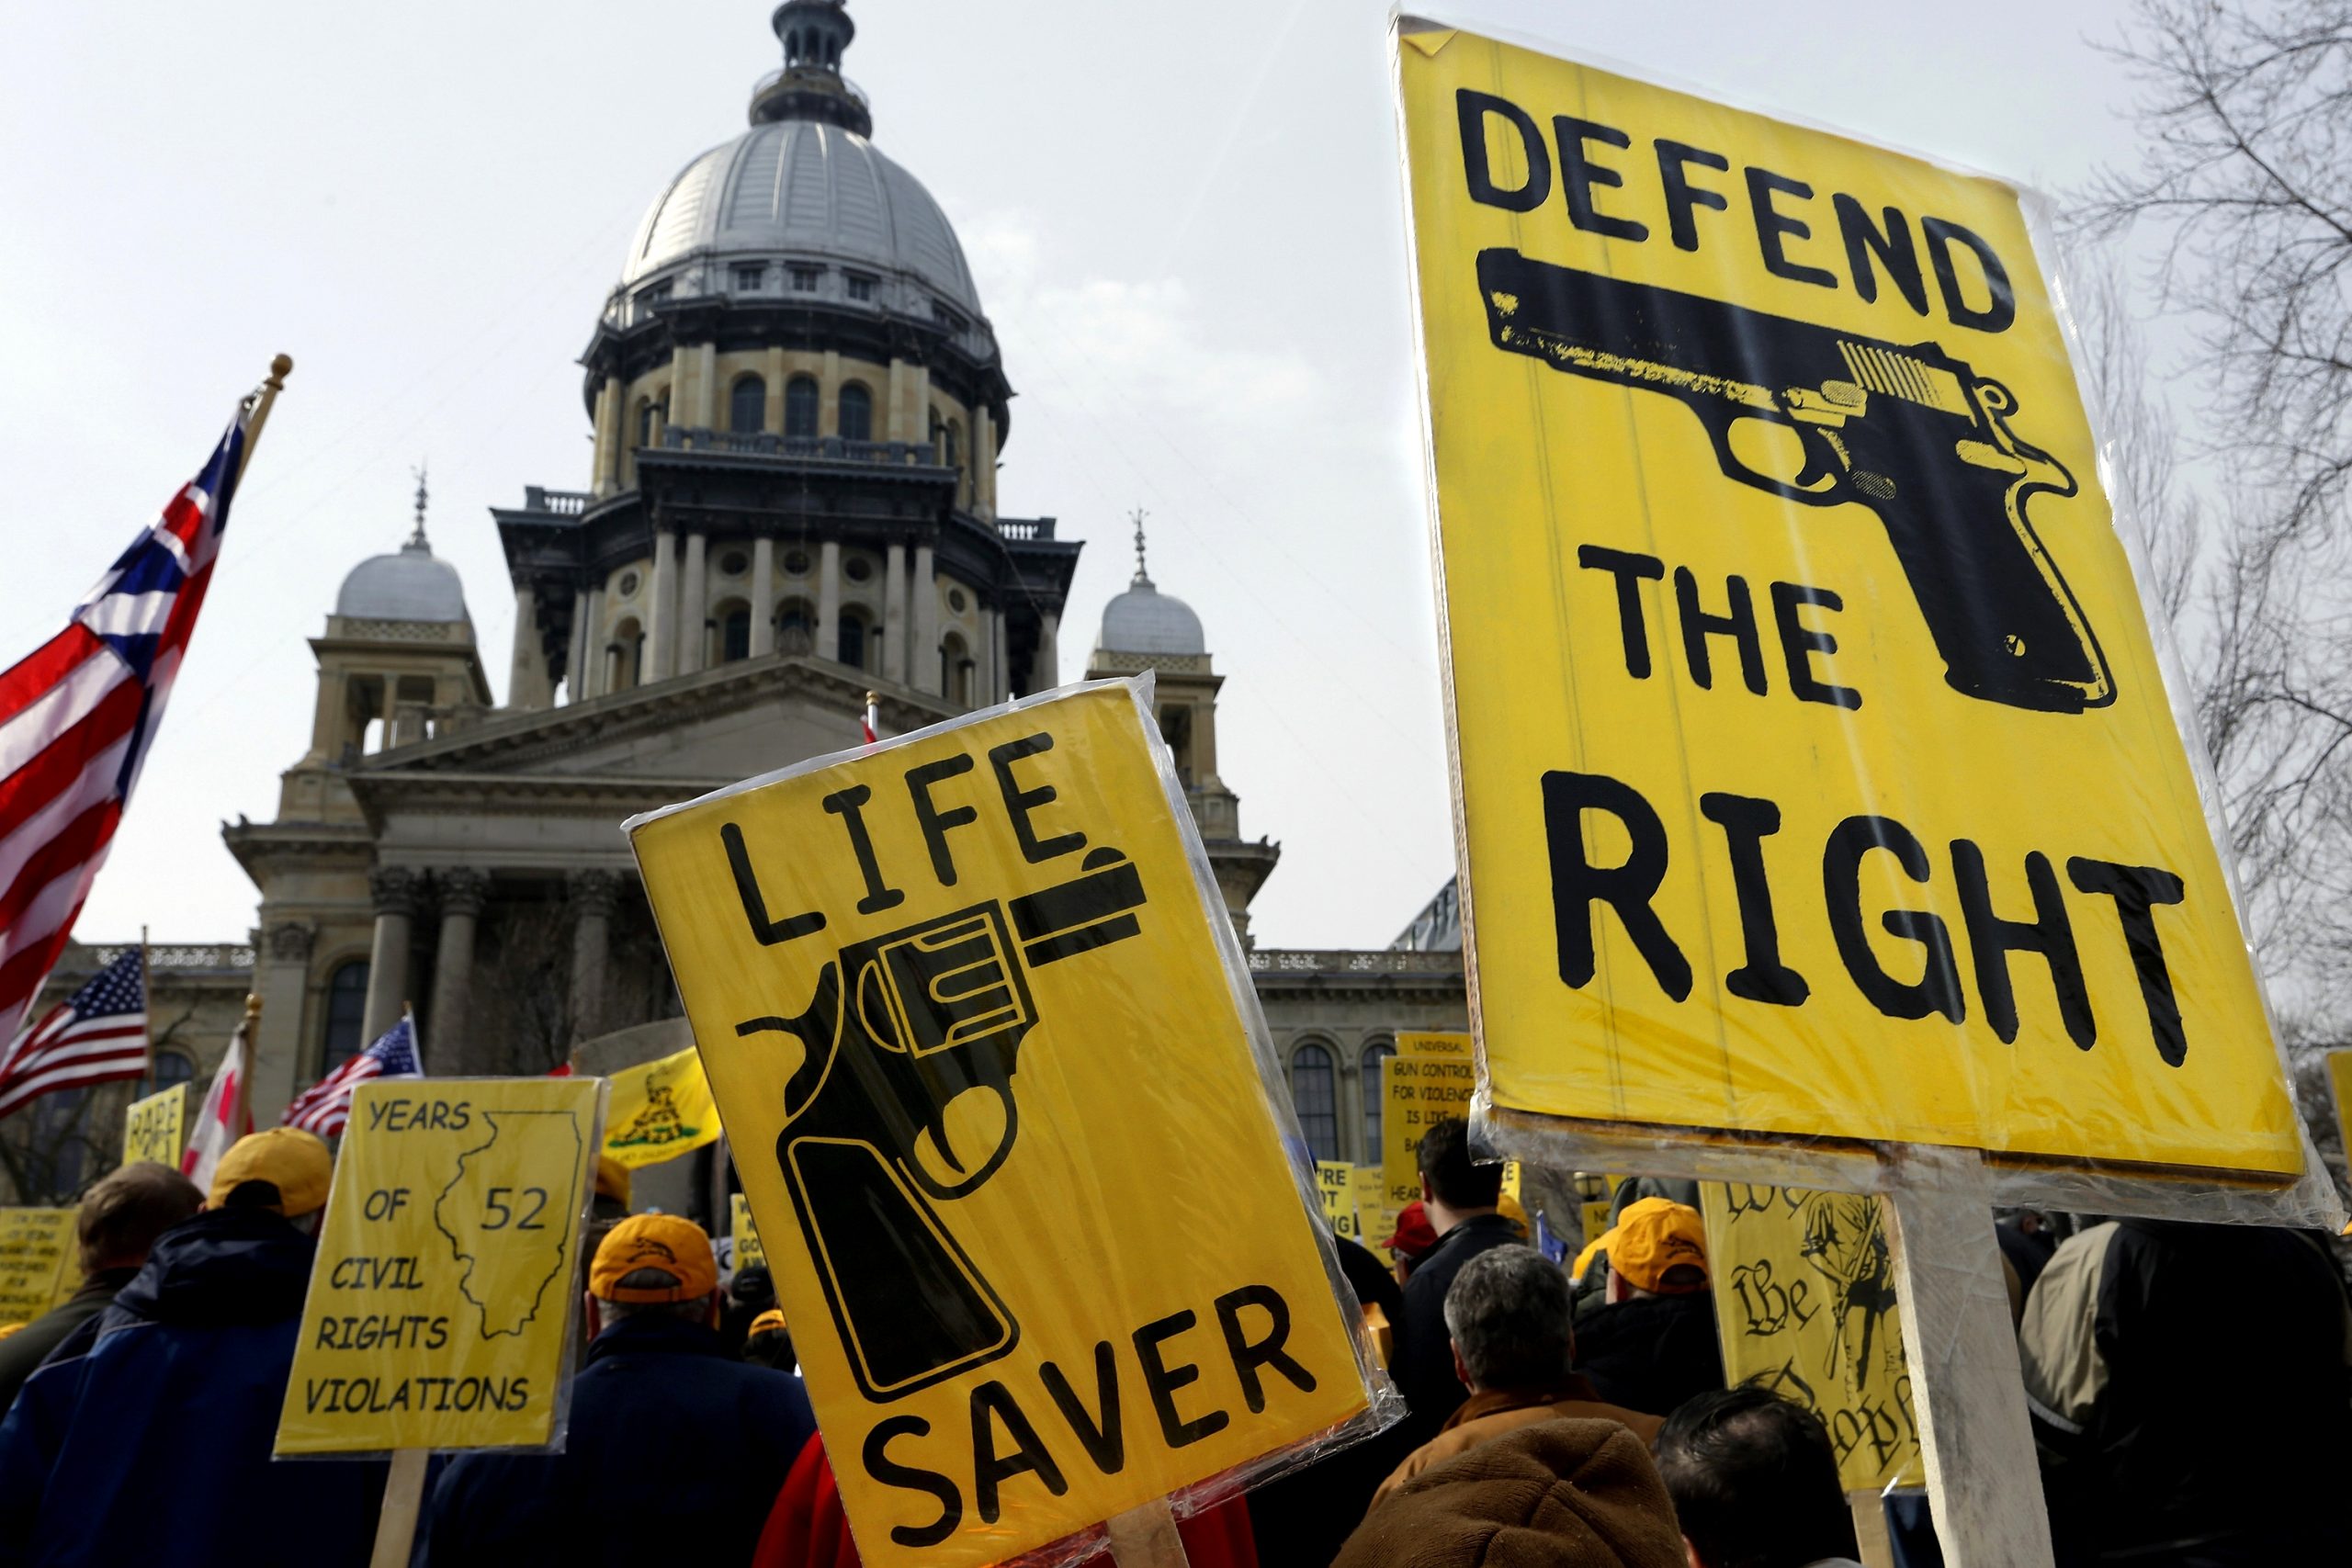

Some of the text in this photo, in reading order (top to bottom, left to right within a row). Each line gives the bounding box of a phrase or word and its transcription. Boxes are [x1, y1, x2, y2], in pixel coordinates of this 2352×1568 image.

[1456, 88, 2016, 333] DEFEND
[1577, 543, 1861, 711] THE
[720, 731, 1088, 946] LIFE
[1542, 770, 2185, 1067] RIGHT
[1413, 1041, 1464, 1053] UNIVERSAL
[1394, 1062, 1474, 1078] GUN CONTROL
[1393, 1085, 1475, 1102] FOR VIOLENC
[369, 1100, 470, 1131] YEARS
[1407, 1110, 1419, 1124] IS
[364, 1189, 411, 1222] OF
[481, 1188, 548, 1230] 52
[1391, 1185, 1421, 1201] HEAR
[331, 1257, 424, 1291] CIVIL
[316, 1315, 448, 1349] RIGHTS
[307, 1376, 529, 1414] VIOLATIONS
[862, 1285, 1317, 1547] SAVER
